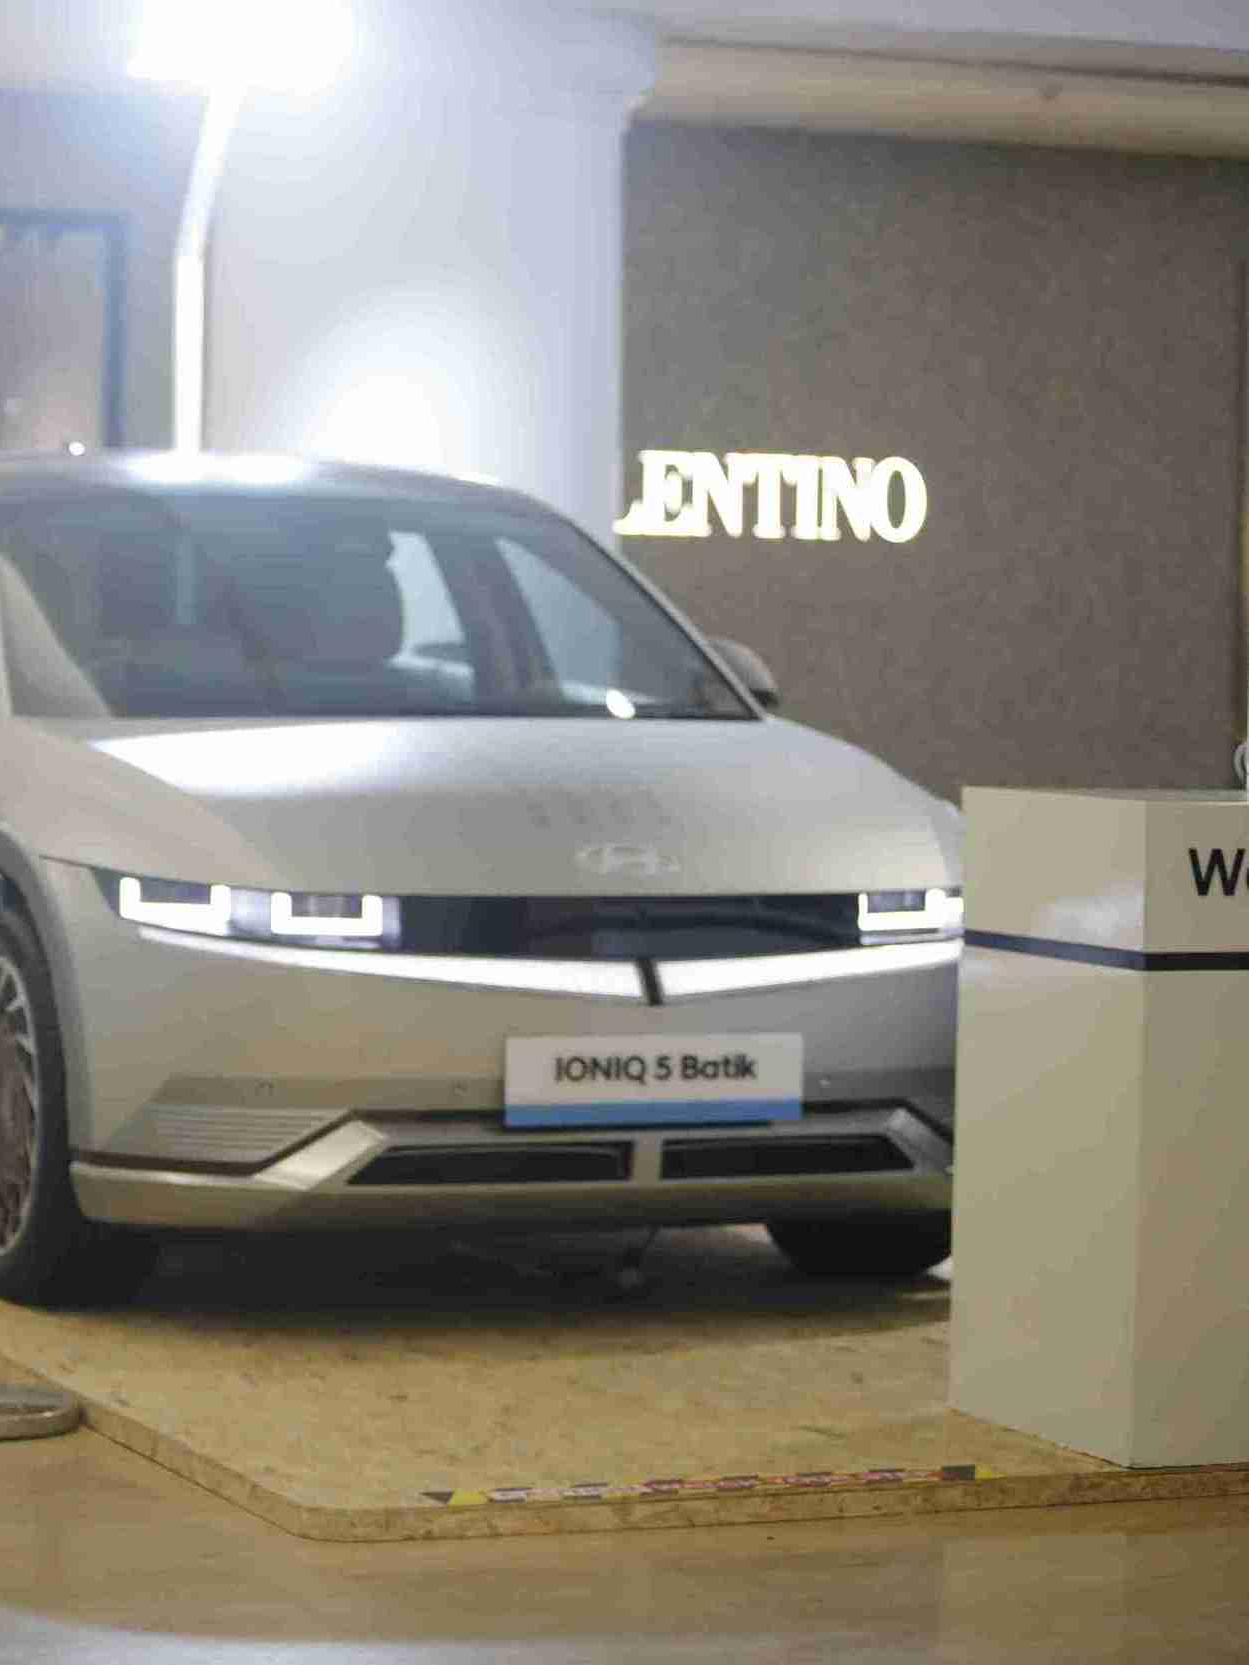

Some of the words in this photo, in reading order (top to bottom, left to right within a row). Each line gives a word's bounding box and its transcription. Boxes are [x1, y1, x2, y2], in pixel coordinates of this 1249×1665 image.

[1188, 847, 1249, 897] W
[554, 1056, 647, 1085] IONIQ
[655, 1055, 672, 1081] 5
[680, 1054, 757, 1080] Batik
